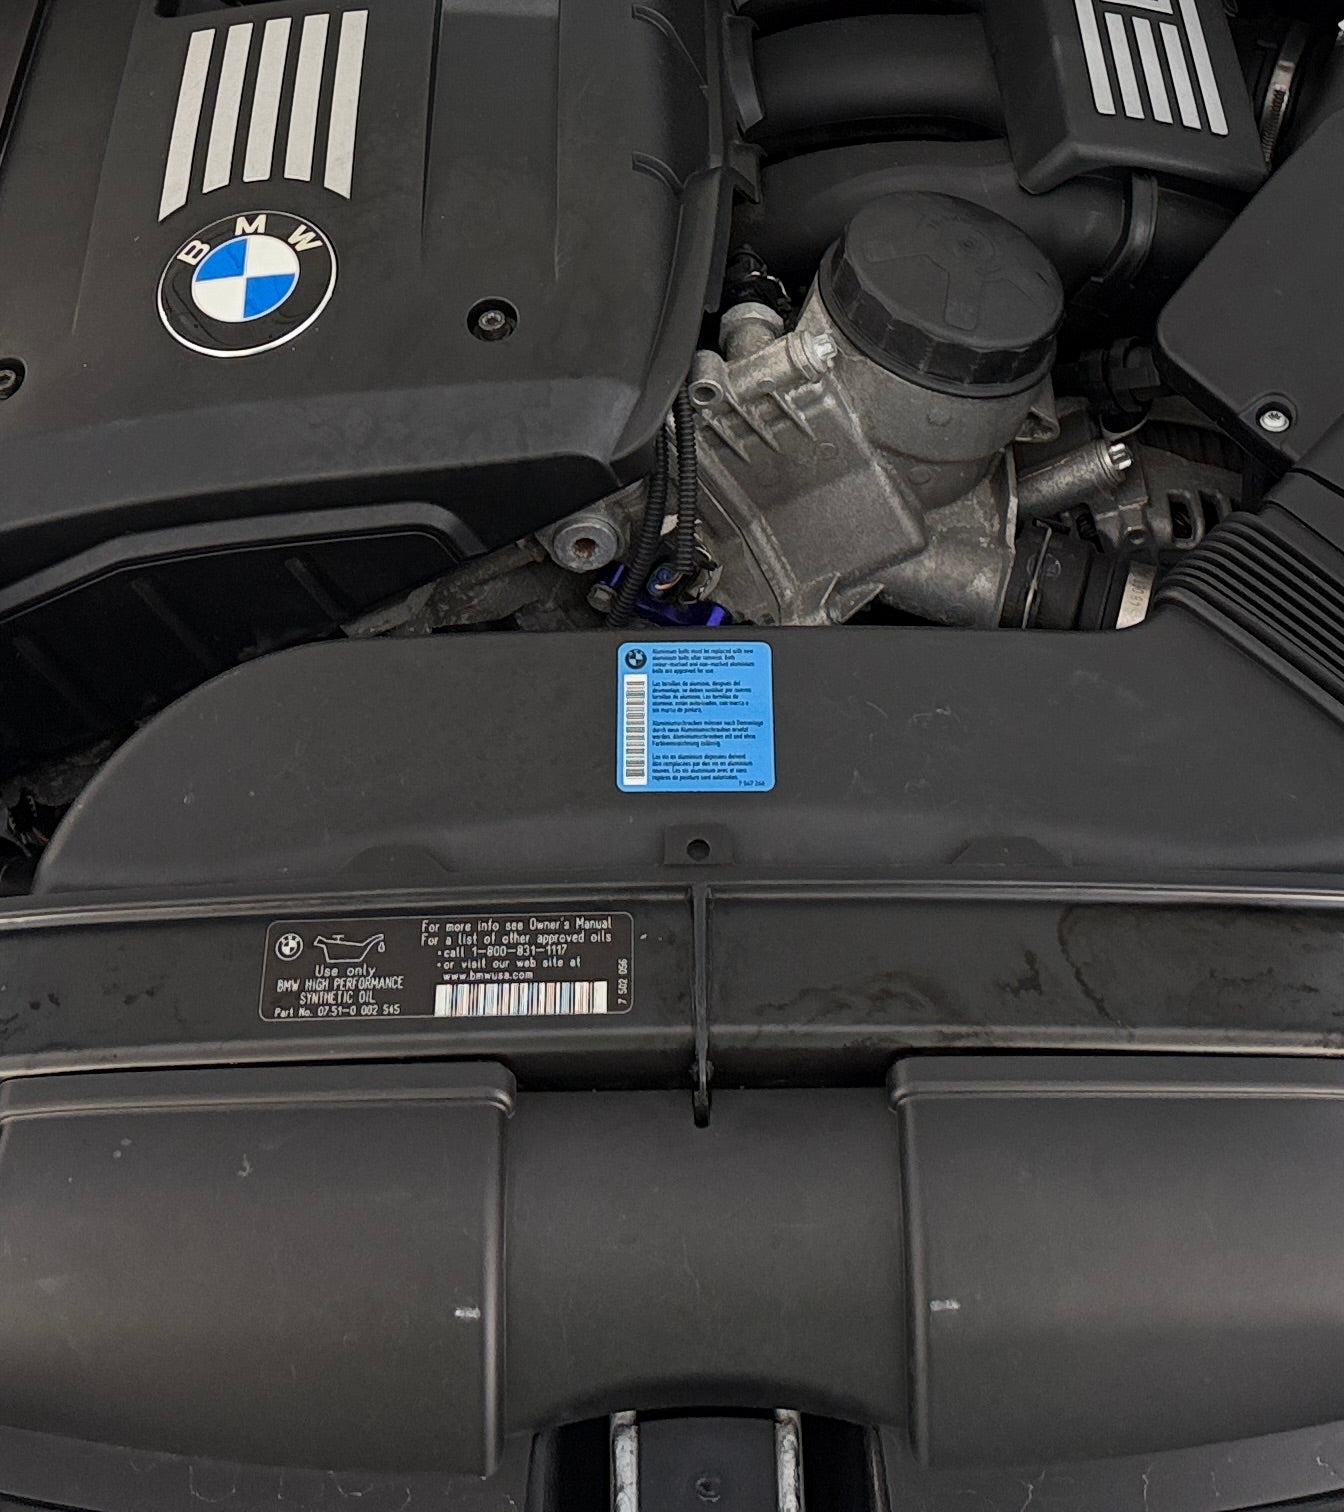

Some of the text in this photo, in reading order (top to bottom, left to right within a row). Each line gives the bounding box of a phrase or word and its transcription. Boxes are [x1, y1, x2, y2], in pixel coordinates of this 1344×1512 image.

[176, 214, 323, 266] BMW
[421, 916, 612, 932] For more info see Owner's Manual
[420, 930, 612, 946] For a list of other approved oils
[461, 958, 486, 969] visit
[492, 960, 510, 968] our
[516, 957, 536, 967] web
[542, 956, 563, 968] site
[569, 955, 581, 968] at
[315, 963, 376, 979] Use only
[442, 970, 533, 981] www.bmwusa.com
[276, 975, 404, 993] BMW HIGH PERFORMANCE
[299, 990, 376, 1005] SYNTHETIC OIL
[273, 1007, 294, 1018] Part
